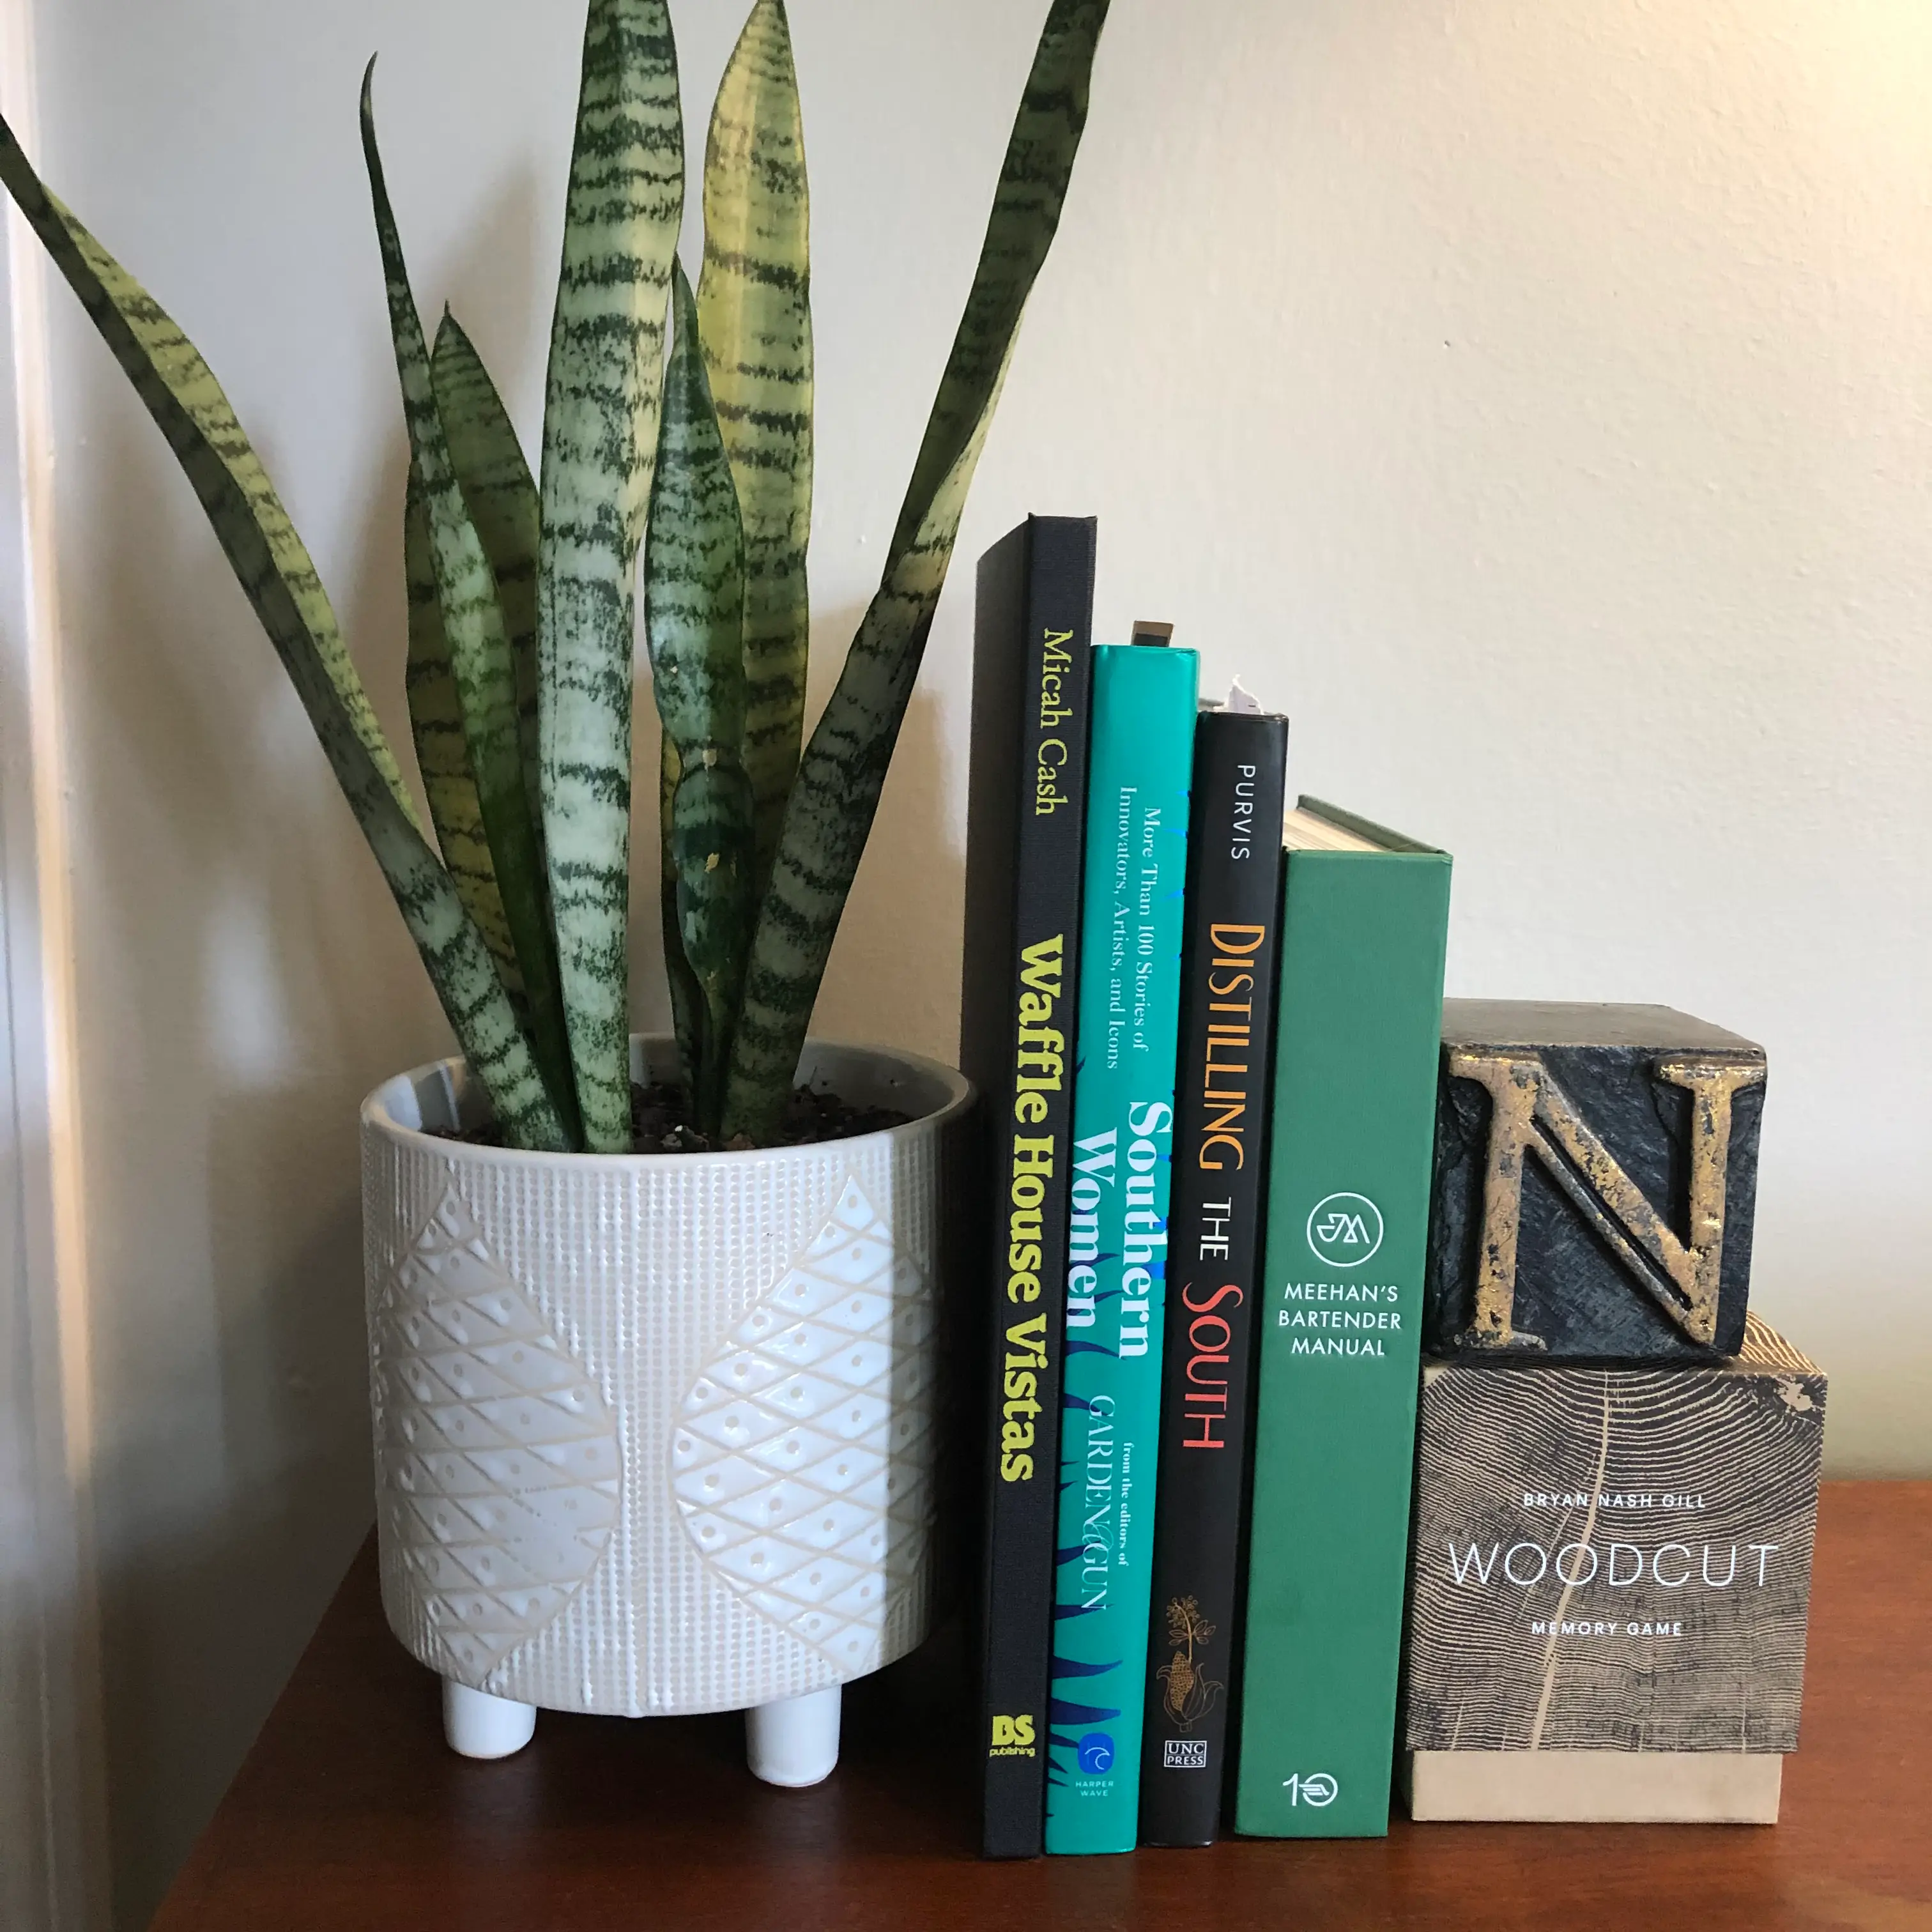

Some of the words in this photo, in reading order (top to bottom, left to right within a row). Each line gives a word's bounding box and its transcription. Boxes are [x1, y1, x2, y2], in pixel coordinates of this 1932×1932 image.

[1039, 627, 1073, 729] Micah
[1036, 739, 1068, 815] Cash
[1142, 807, 1161, 857] More
[1231, 765, 1255, 859] PURVIS
[1112, 786, 1137, 894] Innovators,
[1139, 863, 1158, 916] Than
[1109, 901, 1130, 970] Artists,
[1137, 925, 1154, 955] 100
[1110, 978, 1126, 1012] and
[1133, 962, 1153, 1026] Stories
[1015, 933, 1064, 1123] Waffle
[1107, 1020, 1125, 1069] Icons
[1133, 1032, 1149, 1052] of
[1199, 924, 1265, 1170] DISTILLING
[1008, 1134, 1054, 1303] House
[1448, 1052, 1766, 1352] N
[1066, 1127, 1117, 1330] Women
[1119, 1101, 1174, 1360] Southern
[1200, 1197, 1232, 1261] THE
[1284, 1282, 1398, 1302] MEEHAN'S
[1278, 1309, 1401, 1330] BARTENDER
[1183, 1282, 1243, 1448] SOUTH
[1291, 1337, 1385, 1356] MANUAL
[1000, 1312, 1048, 1482] Vistas
[1123, 1442, 1135, 1473] from
[1121, 1478, 1132, 1499] the
[1524, 1493, 1588, 1506] BRYAN
[1598, 1494, 1652, 1507] NASH
[1662, 1494, 1705, 1508] GILL
[1119, 1503, 1131, 1549] editors
[1118, 1552, 1129, 1566] of
[1448, 1542, 1779, 1587] WOODCUT
[1531, 1621, 1617, 1636] MEMORY
[1627, 1622, 1682, 1636] GAME
[989, 1747, 1036, 1758] publishing
[1167, 1743, 1204, 1754] UNC
[1167, 1756, 1204, 1765] PRESS
